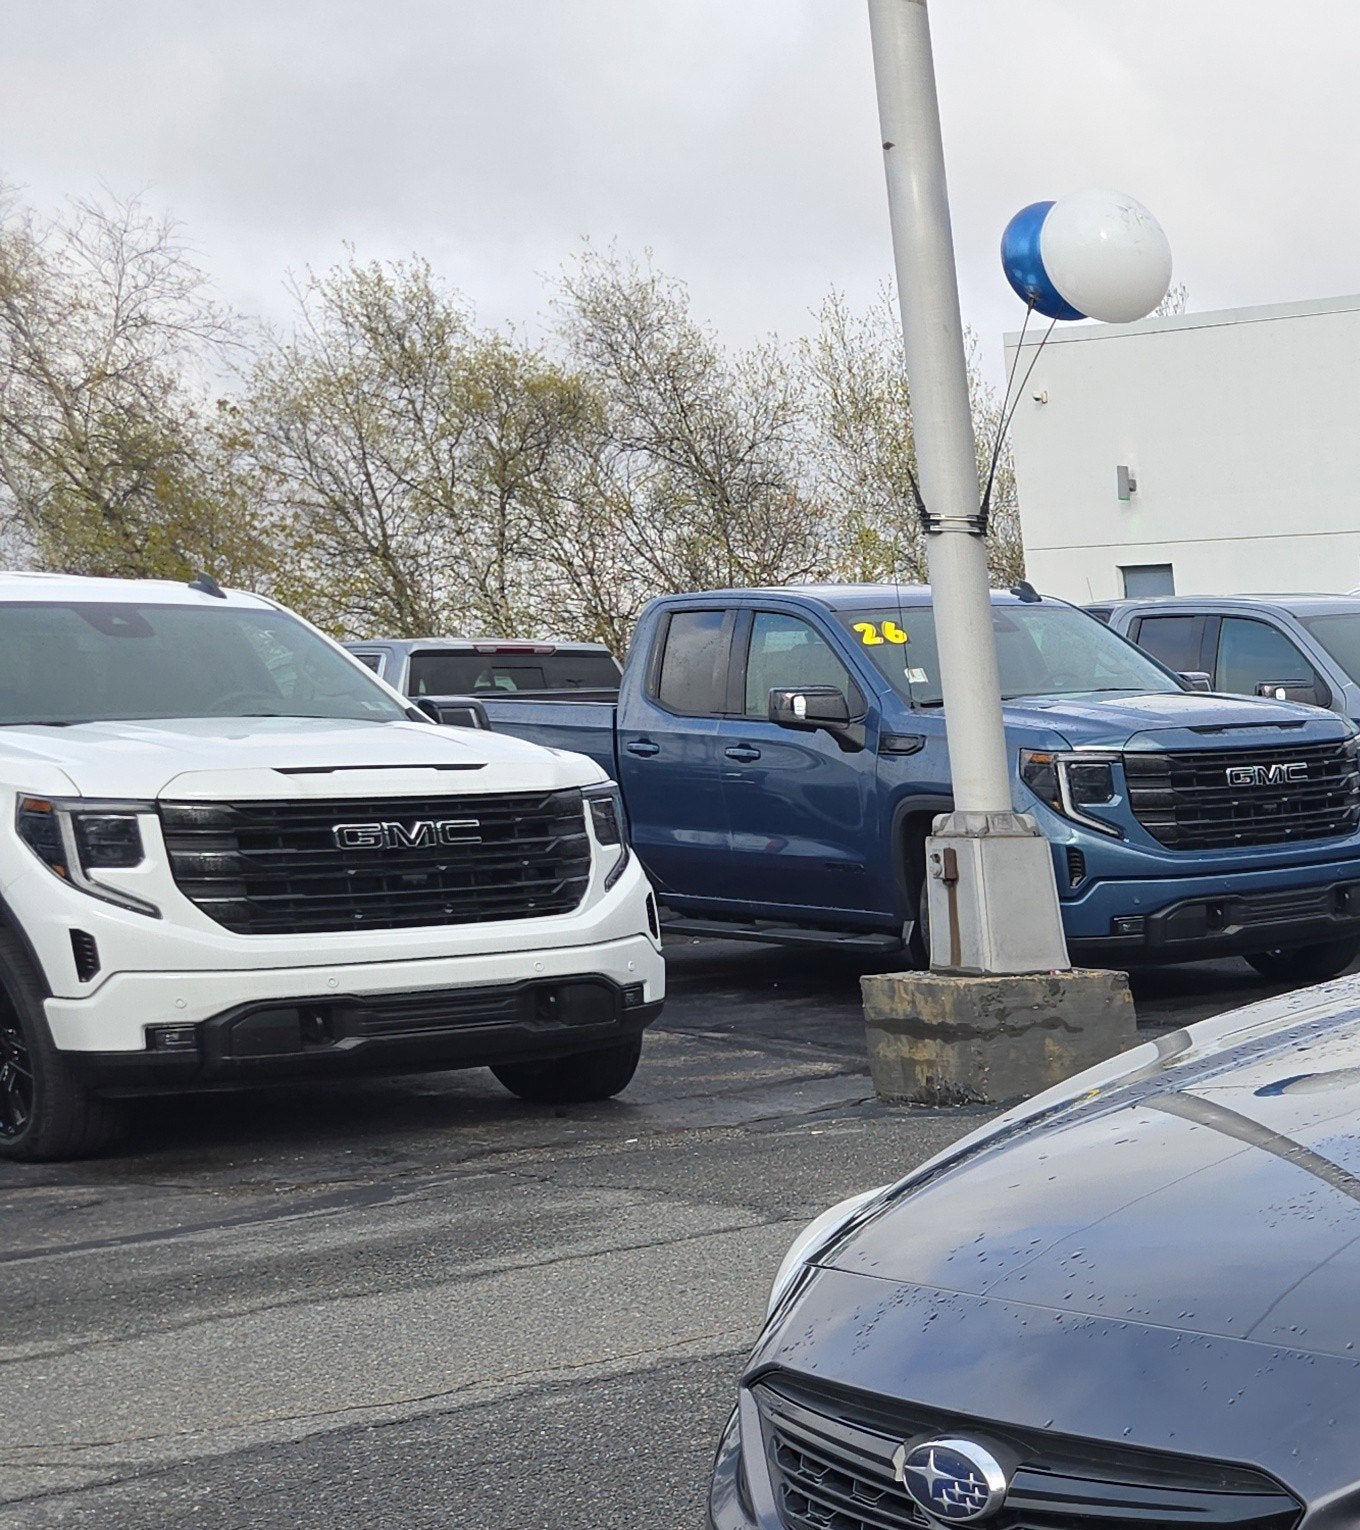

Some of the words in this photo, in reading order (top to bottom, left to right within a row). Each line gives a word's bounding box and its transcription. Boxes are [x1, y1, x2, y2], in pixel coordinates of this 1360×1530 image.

[853, 620, 908, 645] 26
[1225, 762, 1309, 787] GMC
[332, 819, 482, 850] GMC
